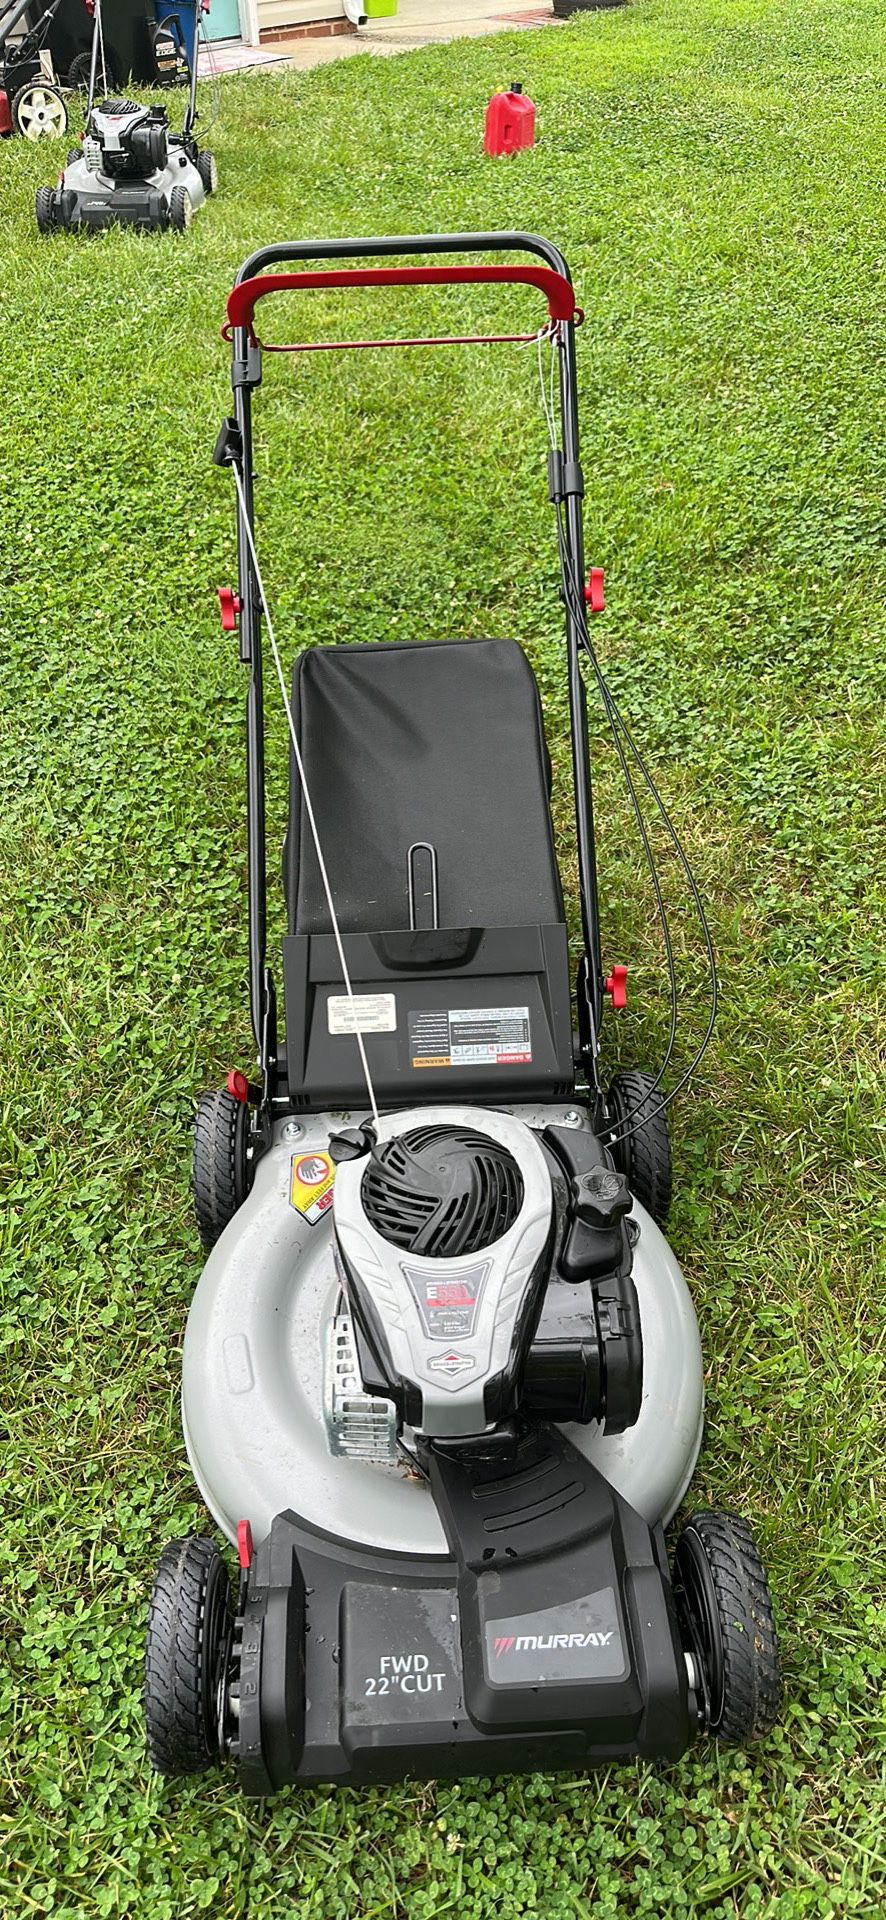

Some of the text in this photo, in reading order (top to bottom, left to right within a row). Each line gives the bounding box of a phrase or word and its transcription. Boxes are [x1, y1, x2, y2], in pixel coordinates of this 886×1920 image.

[156, 48, 177, 56] EDGE
[497, 1054, 524, 1062] DANGER
[303, 1197, 315, 1209] AWAY
[515, 1631, 614, 1651] MURRAY
[380, 1654, 429, 1674] FWD
